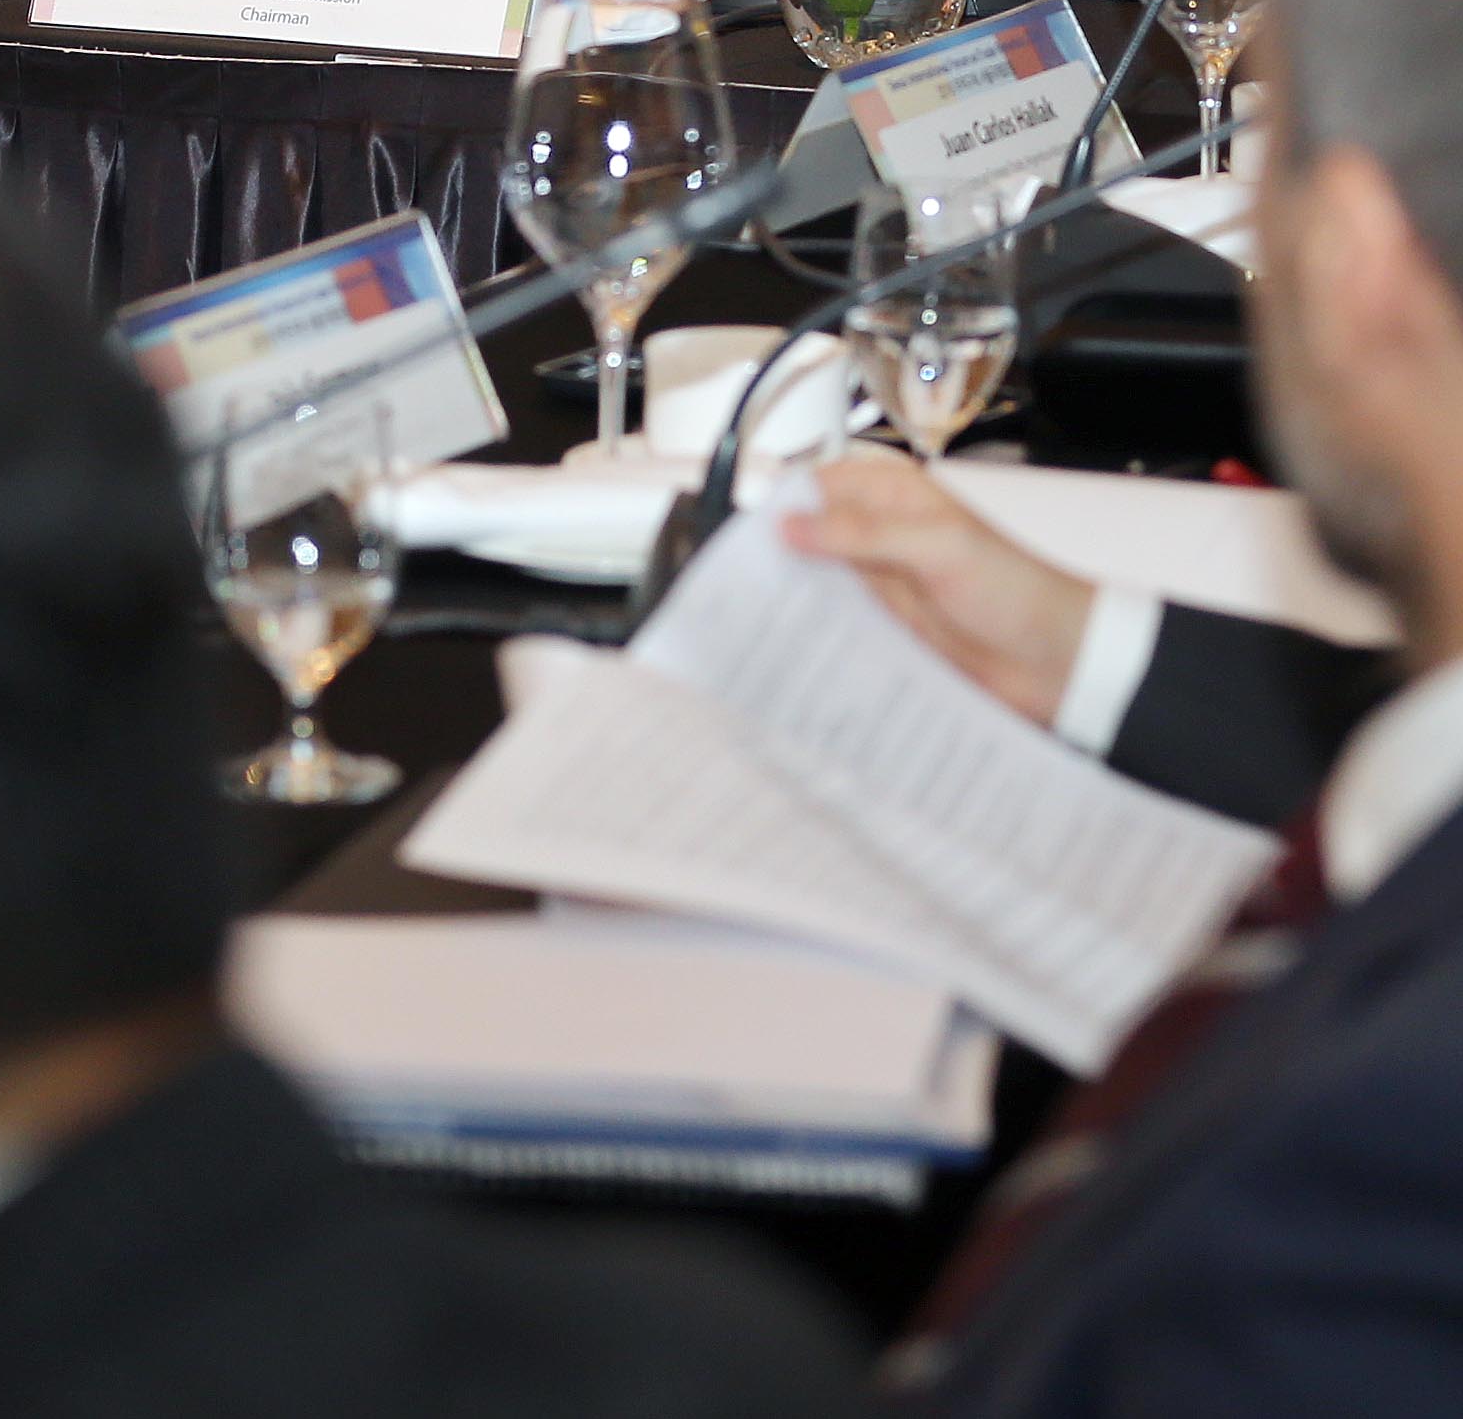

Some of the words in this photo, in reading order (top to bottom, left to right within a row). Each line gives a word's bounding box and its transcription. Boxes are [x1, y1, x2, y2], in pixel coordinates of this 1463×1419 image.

[240, 7, 310, 25] Chairman
[940, 132, 977, 158] Juan
[972, 114, 1017, 144] Carlos
[1011, 95, 1059, 130] Hallak
